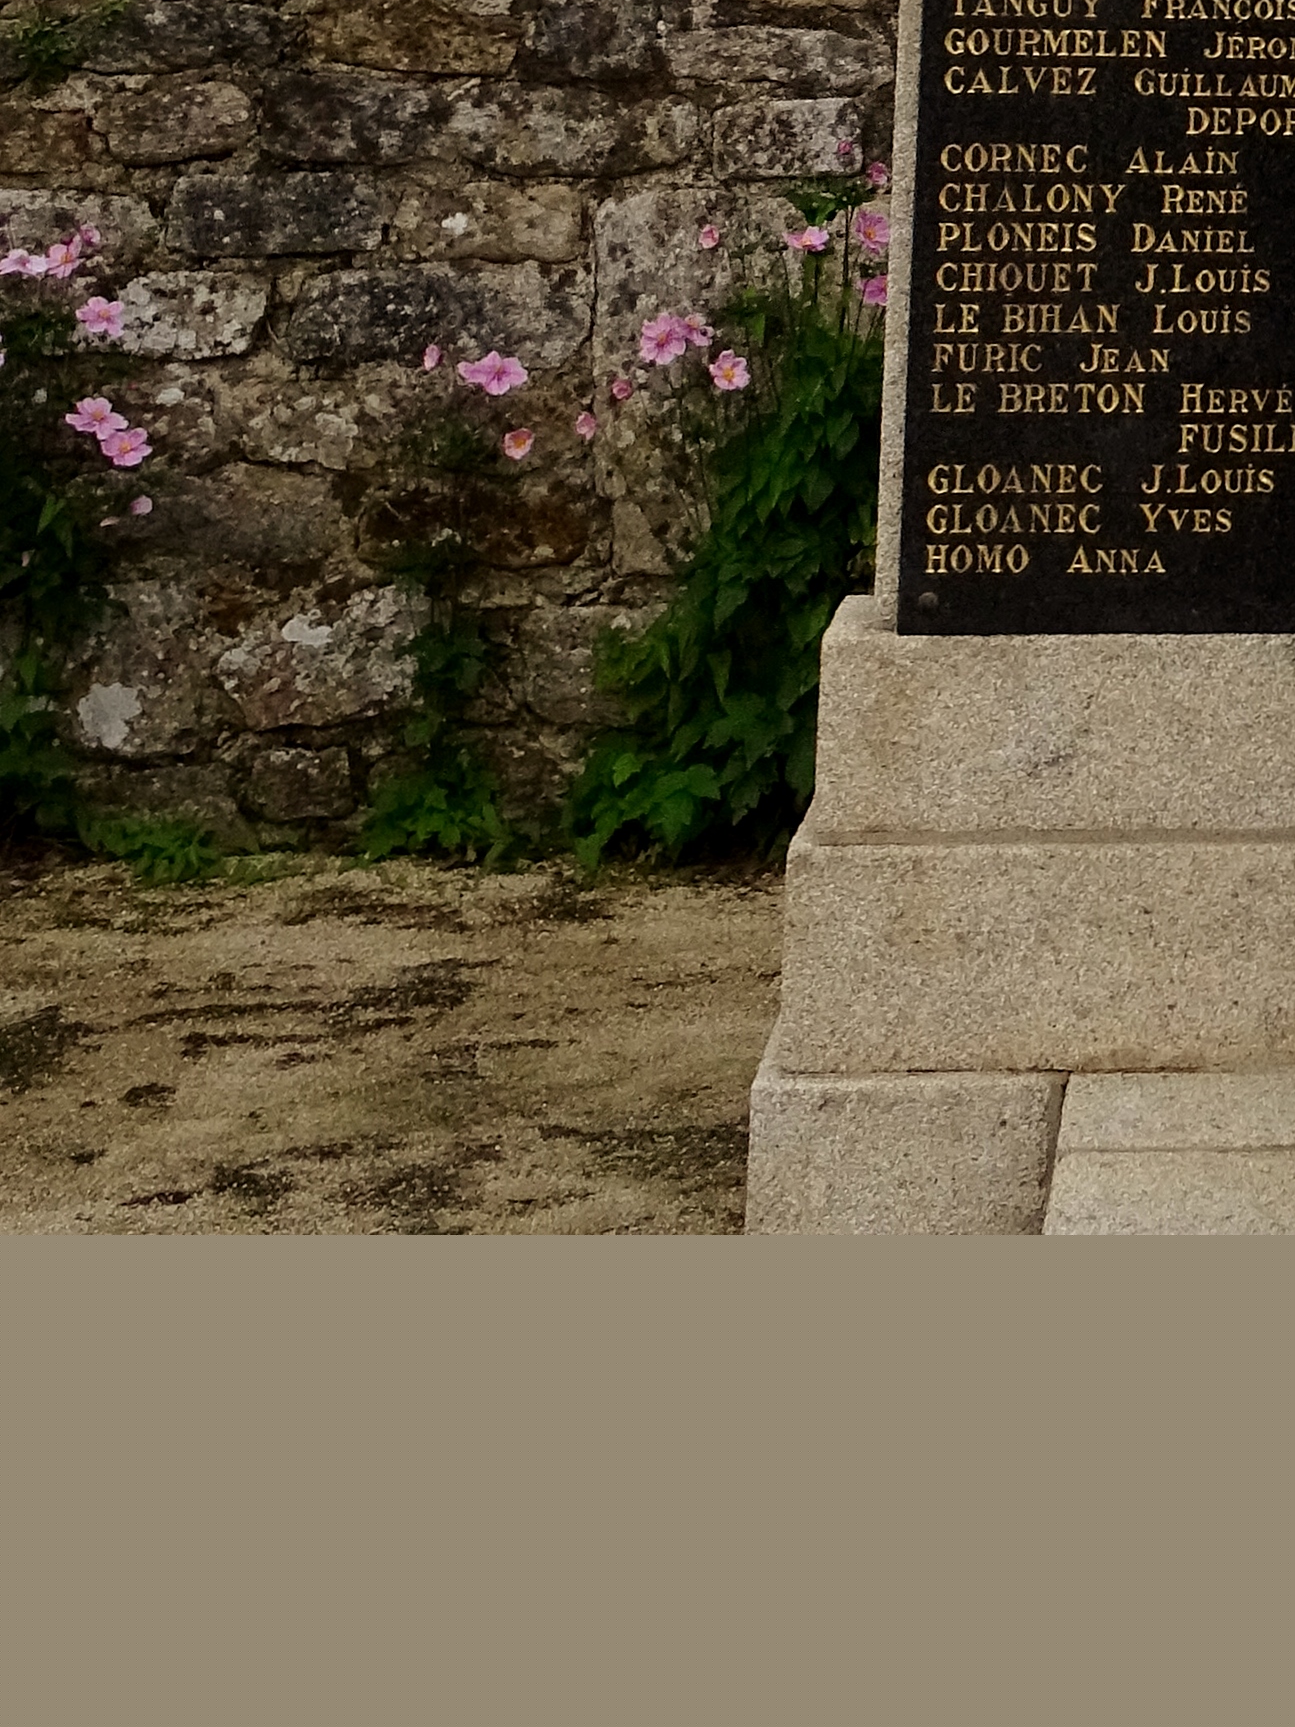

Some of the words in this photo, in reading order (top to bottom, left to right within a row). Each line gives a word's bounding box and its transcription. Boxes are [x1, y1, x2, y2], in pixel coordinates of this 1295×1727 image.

[945, 28, 1166, 58] GOURMELEN
[945, 66, 1096, 95] CALVEZ
[941, 143, 1087, 173] CORNEC
[939, 183, 1125, 213] CHALONY
[937, 222, 1096, 252] PLONEIS
[936, 262, 1097, 297] CHIQUET
[934, 304, 979, 333] LE
[1003, 304, 1118, 333] BIHAN
[932, 344, 1041, 372] FURIC
[932, 384, 976, 413] LE
[998, 383, 1145, 413] BRETON
[928, 464, 1102, 494] GLOANEC
[927, 504, 1100, 534] GLOANEC
[925, 545, 1029, 573] HOMO
